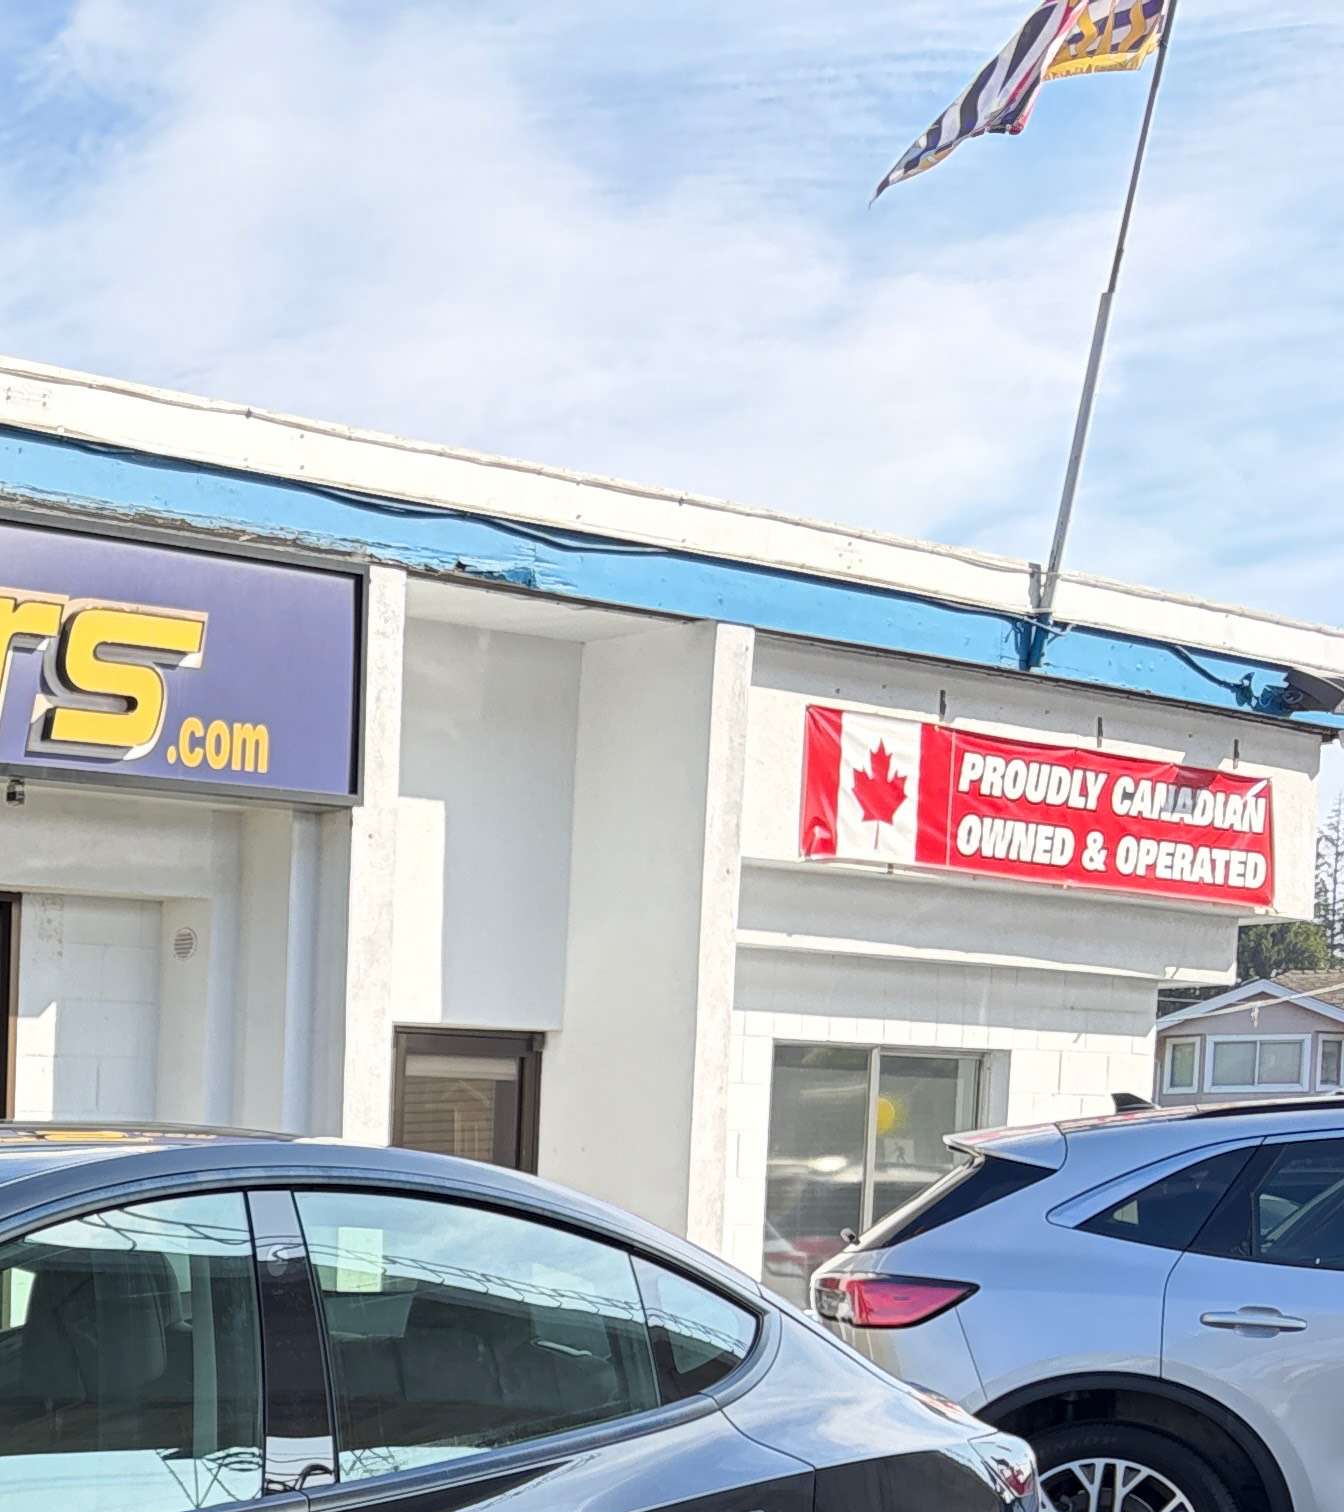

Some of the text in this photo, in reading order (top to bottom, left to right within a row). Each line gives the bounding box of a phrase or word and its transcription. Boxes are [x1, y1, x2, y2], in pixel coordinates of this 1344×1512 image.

[957, 753, 1268, 834] PROUDLY CANADIAN
[957, 815, 1268, 889] OWNED & OPERATED
